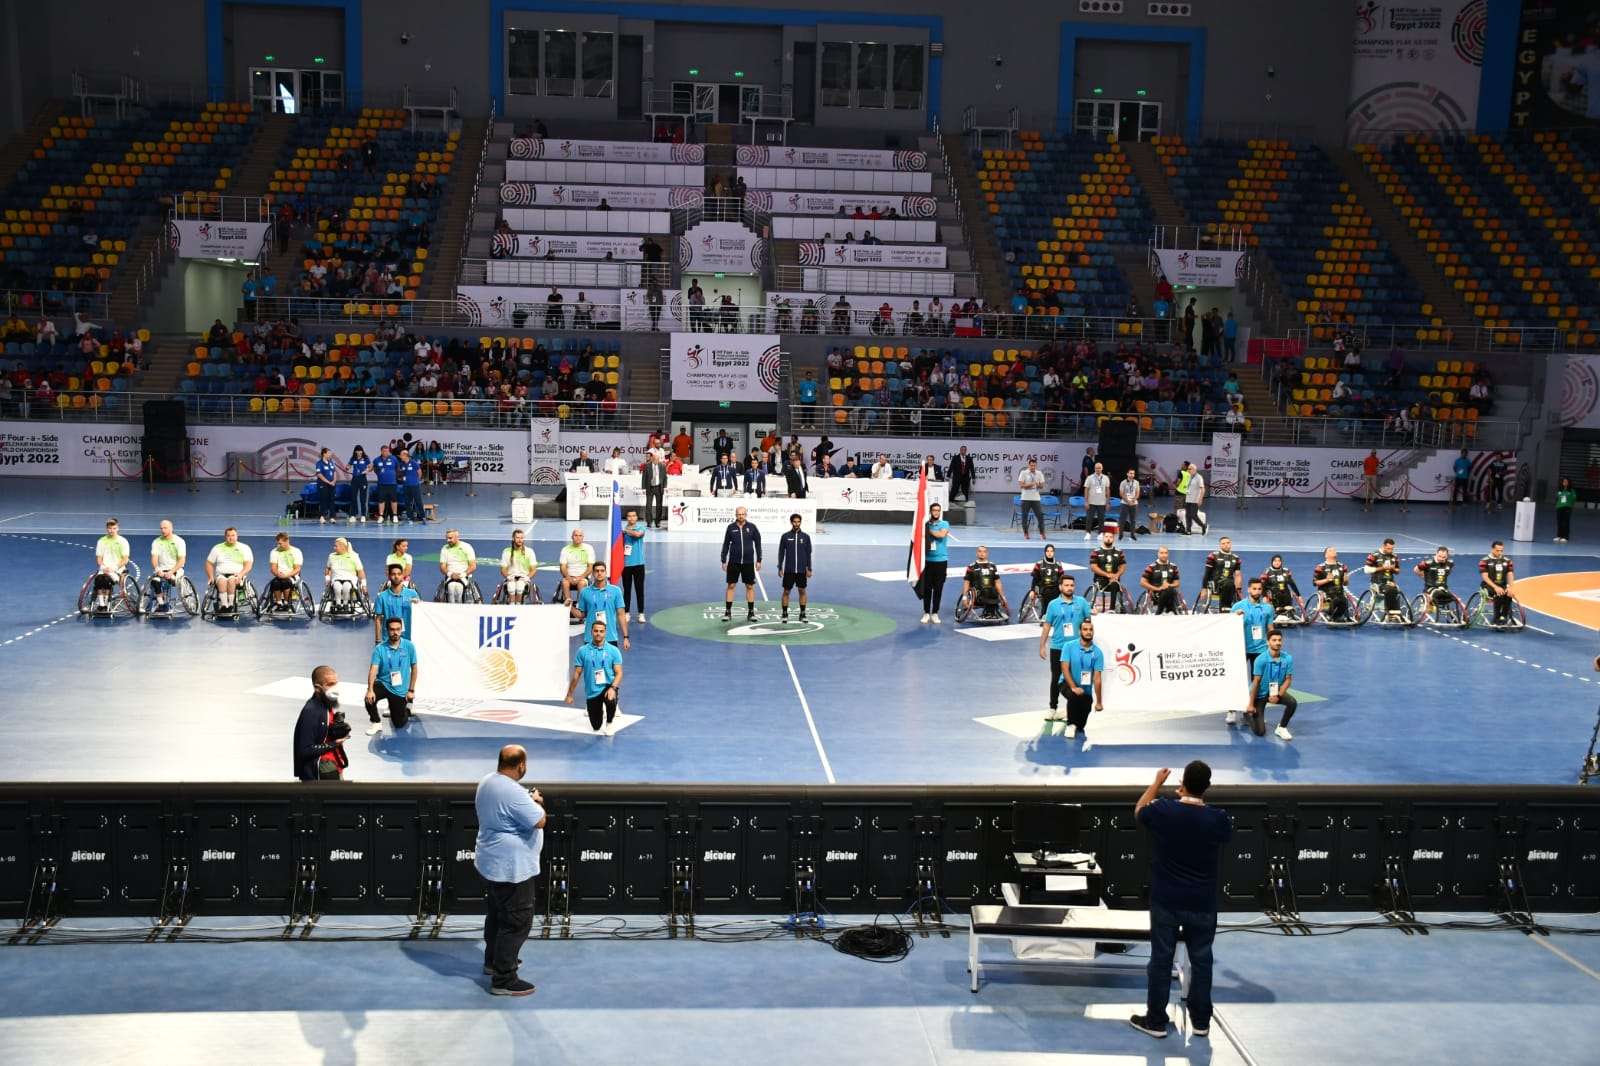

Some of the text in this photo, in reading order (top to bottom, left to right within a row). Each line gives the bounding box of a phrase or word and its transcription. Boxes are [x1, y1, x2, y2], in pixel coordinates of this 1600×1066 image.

[1391, 22, 1416, 30] Egypt
[27, 454, 59, 463] 2022
[475, 463, 504, 472] 2022
[1246, 459, 1252, 475] 1
[1247, 477, 1309, 488] Egypt 2022
[479, 616, 516, 650] IHF
[1157, 653, 1163, 669] 1
[1160, 668, 1226, 680] Egypt 2022
